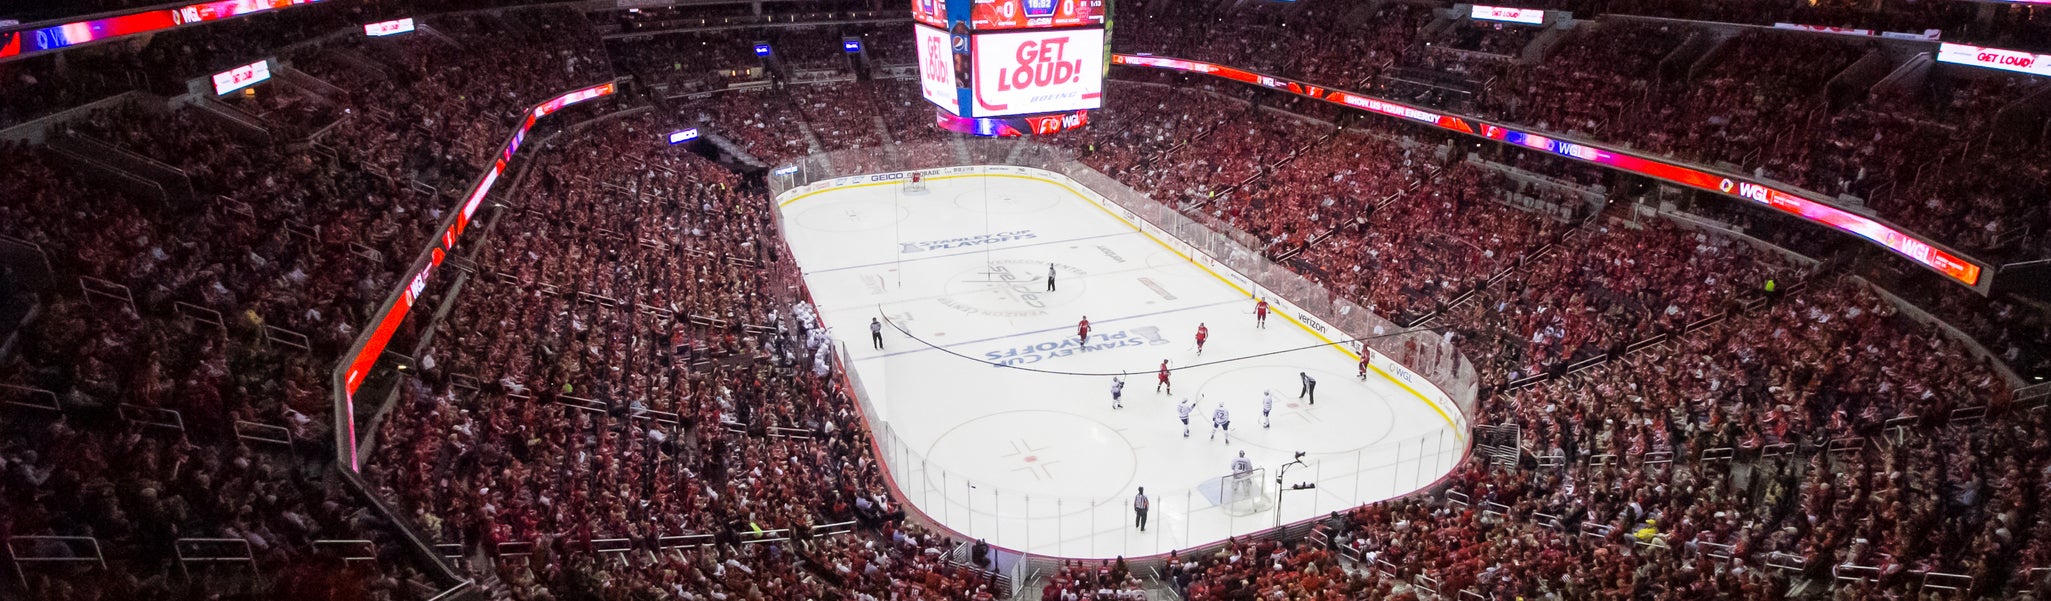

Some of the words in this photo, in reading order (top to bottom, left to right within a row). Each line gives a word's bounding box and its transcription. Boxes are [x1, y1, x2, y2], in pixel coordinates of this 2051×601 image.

[180, 6, 201, 24] WGL
[1003, 1, 1014, 18] 0
[1064, 0, 1073, 16] 0
[927, 35, 941, 58] GET
[1015, 36, 1069, 65] GET
[1125, 56, 1140, 65] WGL
[1977, 52, 1999, 63] GET
[1999, 54, 2035, 68] LOUD!
[925, 56, 949, 86] LOUD!
[997, 58, 1082, 92] LOUD!
[1262, 76, 1275, 88] WGL
[1030, 91, 1077, 103] BOEING
[1346, 95, 1370, 108] SHOW
[1370, 99, 1381, 110] US
[1382, 104, 1405, 116] YOUR
[1405, 108, 1441, 124] ENERGY
[1061, 113, 1080, 129] WGL
[1558, 141, 1584, 159] WGL
[871, 172, 904, 182] GEICO
[1739, 182, 1770, 204] WGL
[919, 234, 992, 246] STANLEY
[928, 233, 1037, 251] PLAYOFFS
[1901, 236, 1931, 265] WGL
[410, 272, 427, 301] WGL
[1298, 311, 1326, 335] verizon
[993, 353, 1043, 368] CUP
[1395, 367, 1413, 385] WGL
[1237, 462, 1246, 472] 31
